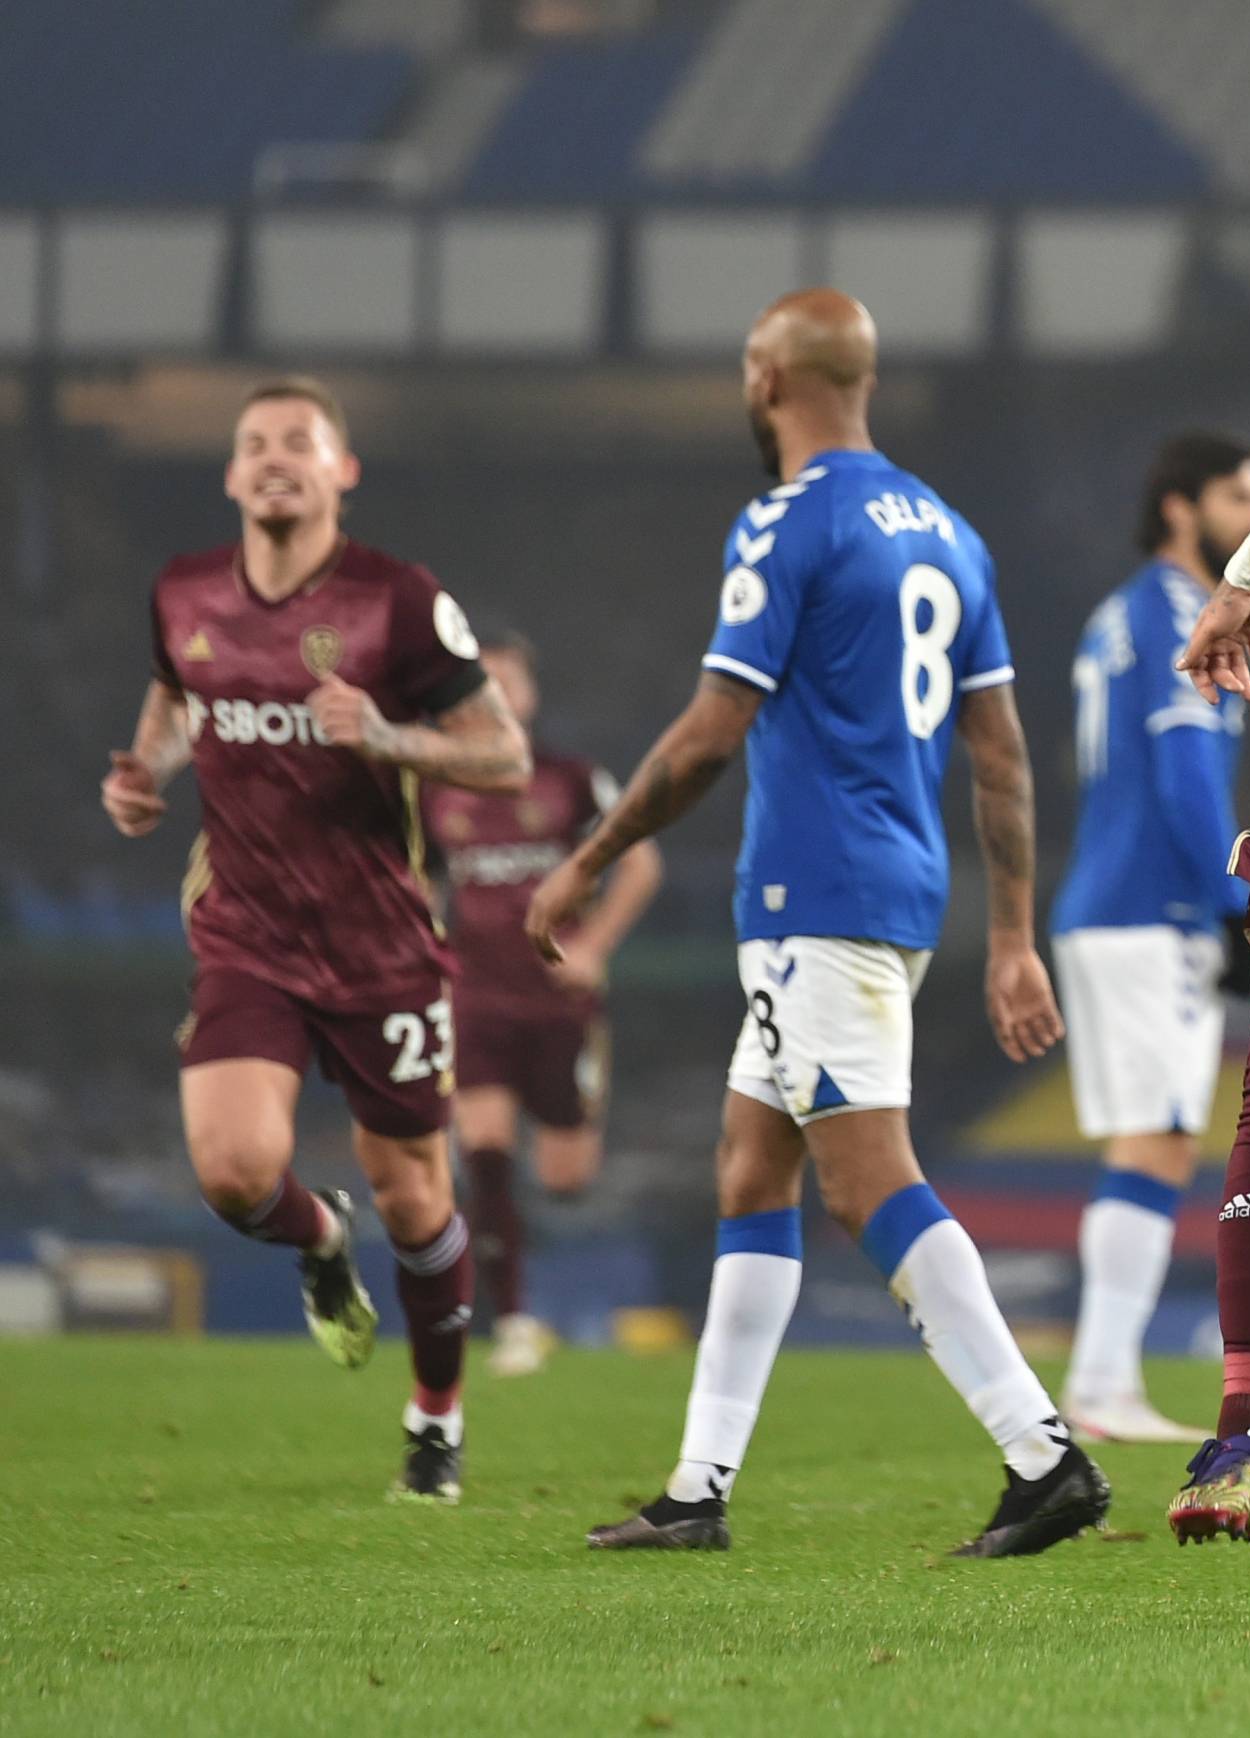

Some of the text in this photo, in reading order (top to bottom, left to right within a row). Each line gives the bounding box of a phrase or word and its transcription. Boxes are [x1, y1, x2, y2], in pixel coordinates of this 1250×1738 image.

[899, 562, 962, 740] 8
[382, 1000, 455, 1084] 23
[751, 989, 780, 1059] 8
